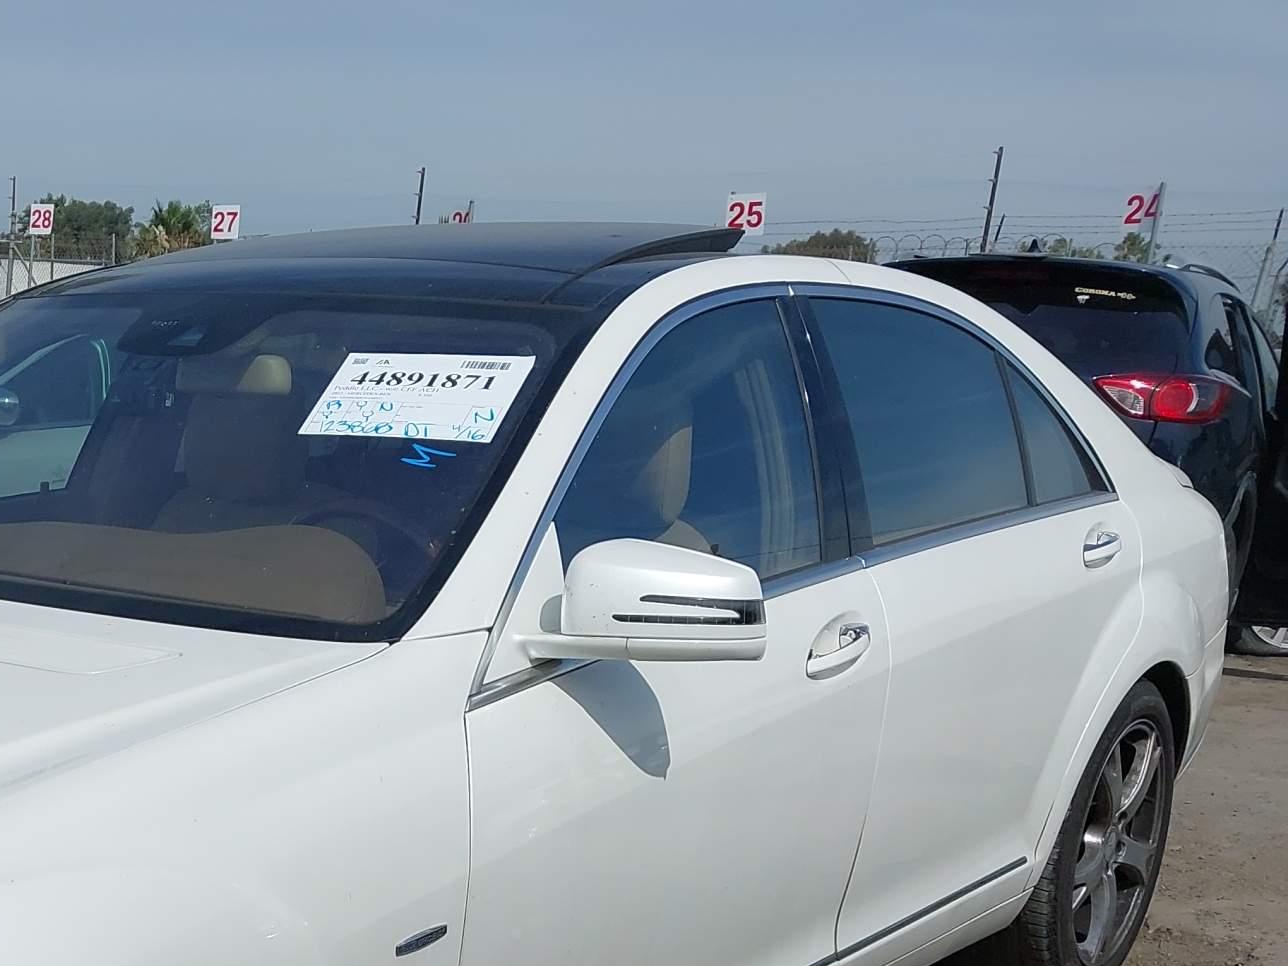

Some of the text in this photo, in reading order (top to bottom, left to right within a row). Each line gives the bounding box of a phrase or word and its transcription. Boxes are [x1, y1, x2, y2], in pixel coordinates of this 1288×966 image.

[31, 209, 52, 228] 28
[728, 201, 763, 228] 25
[1124, 194, 1159, 224] 24
[213, 211, 238, 232] 27
[350, 370, 497, 391] 44891871
[379, 402, 393, 411] N
[474, 408, 495, 424] N
